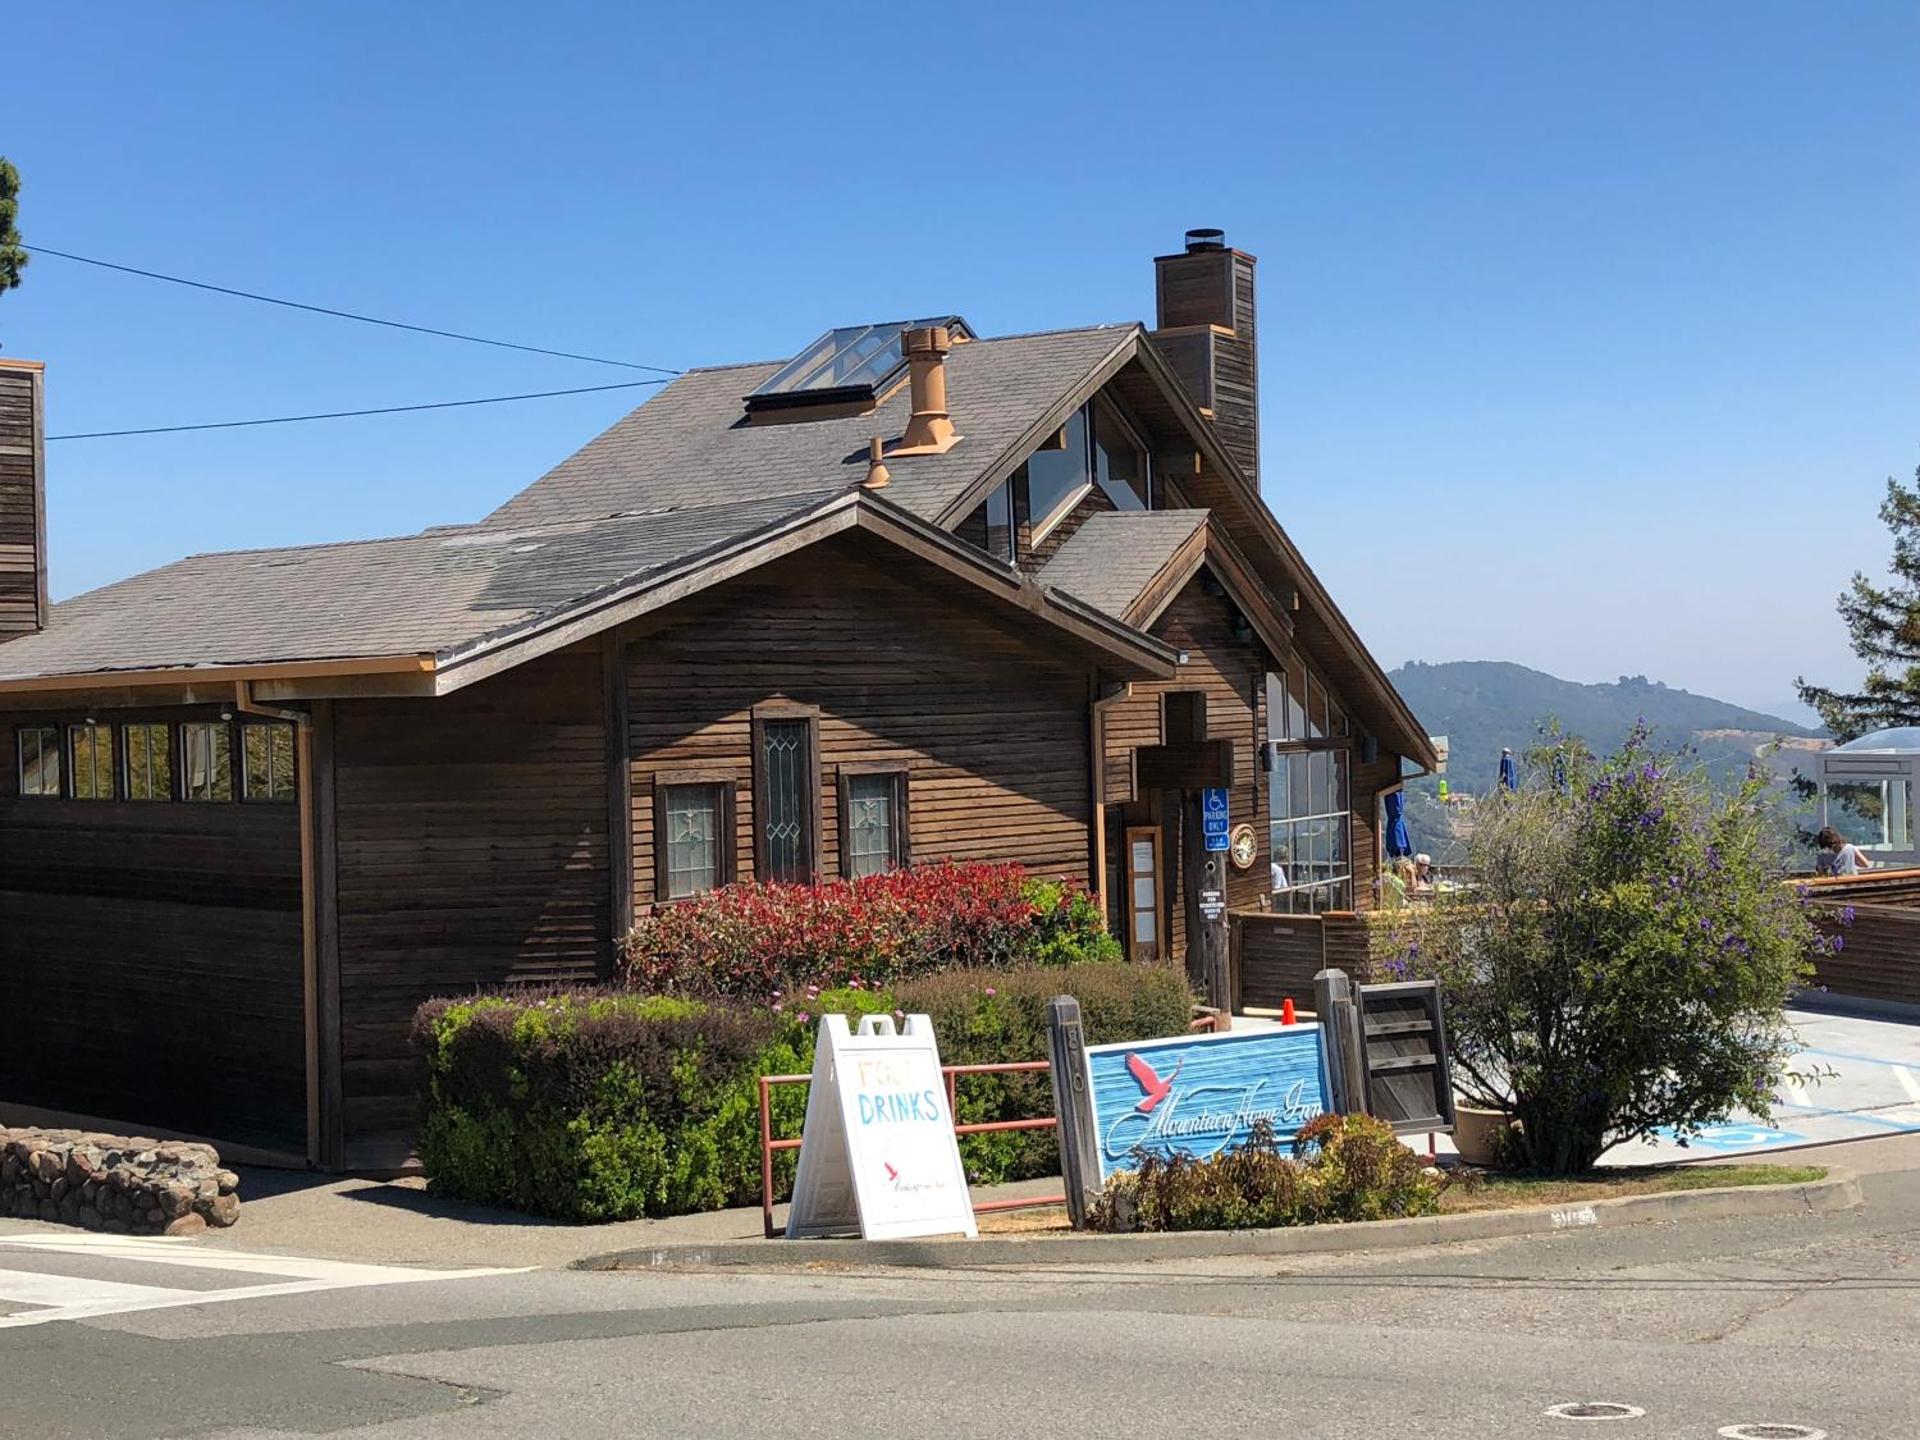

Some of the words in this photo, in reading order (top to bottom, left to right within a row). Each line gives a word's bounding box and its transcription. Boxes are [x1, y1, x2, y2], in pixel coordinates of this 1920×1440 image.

[1205, 811, 1228, 820] PARKING
[1208, 821, 1224, 832] ONLY
[858, 1090, 939, 1125] DRINKS
[1106, 1086, 1234, 1157] Mountain
[1283, 1078, 1323, 1121] Inn
